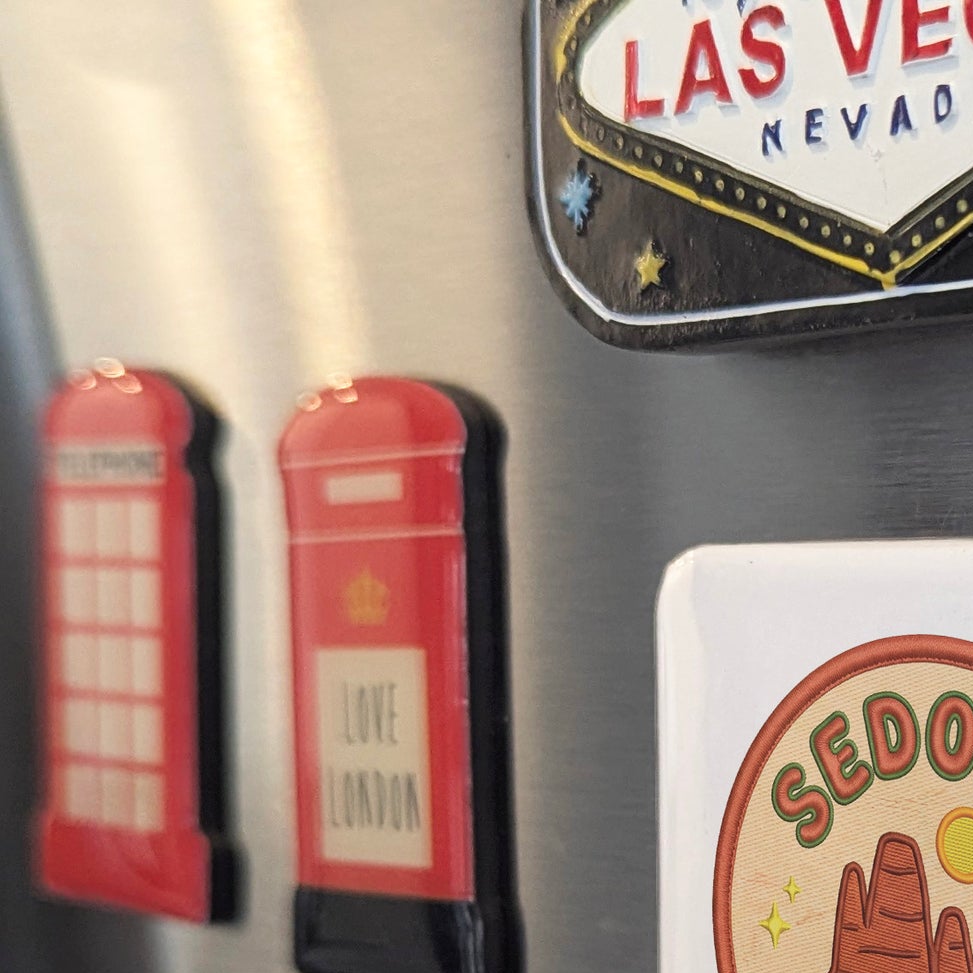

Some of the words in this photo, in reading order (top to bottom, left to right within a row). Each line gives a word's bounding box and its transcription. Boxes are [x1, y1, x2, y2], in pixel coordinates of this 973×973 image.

[624, 4, 786, 122] LAS
[341, 681, 399, 746] LOVE
[328, 766, 422, 832] LONDON
